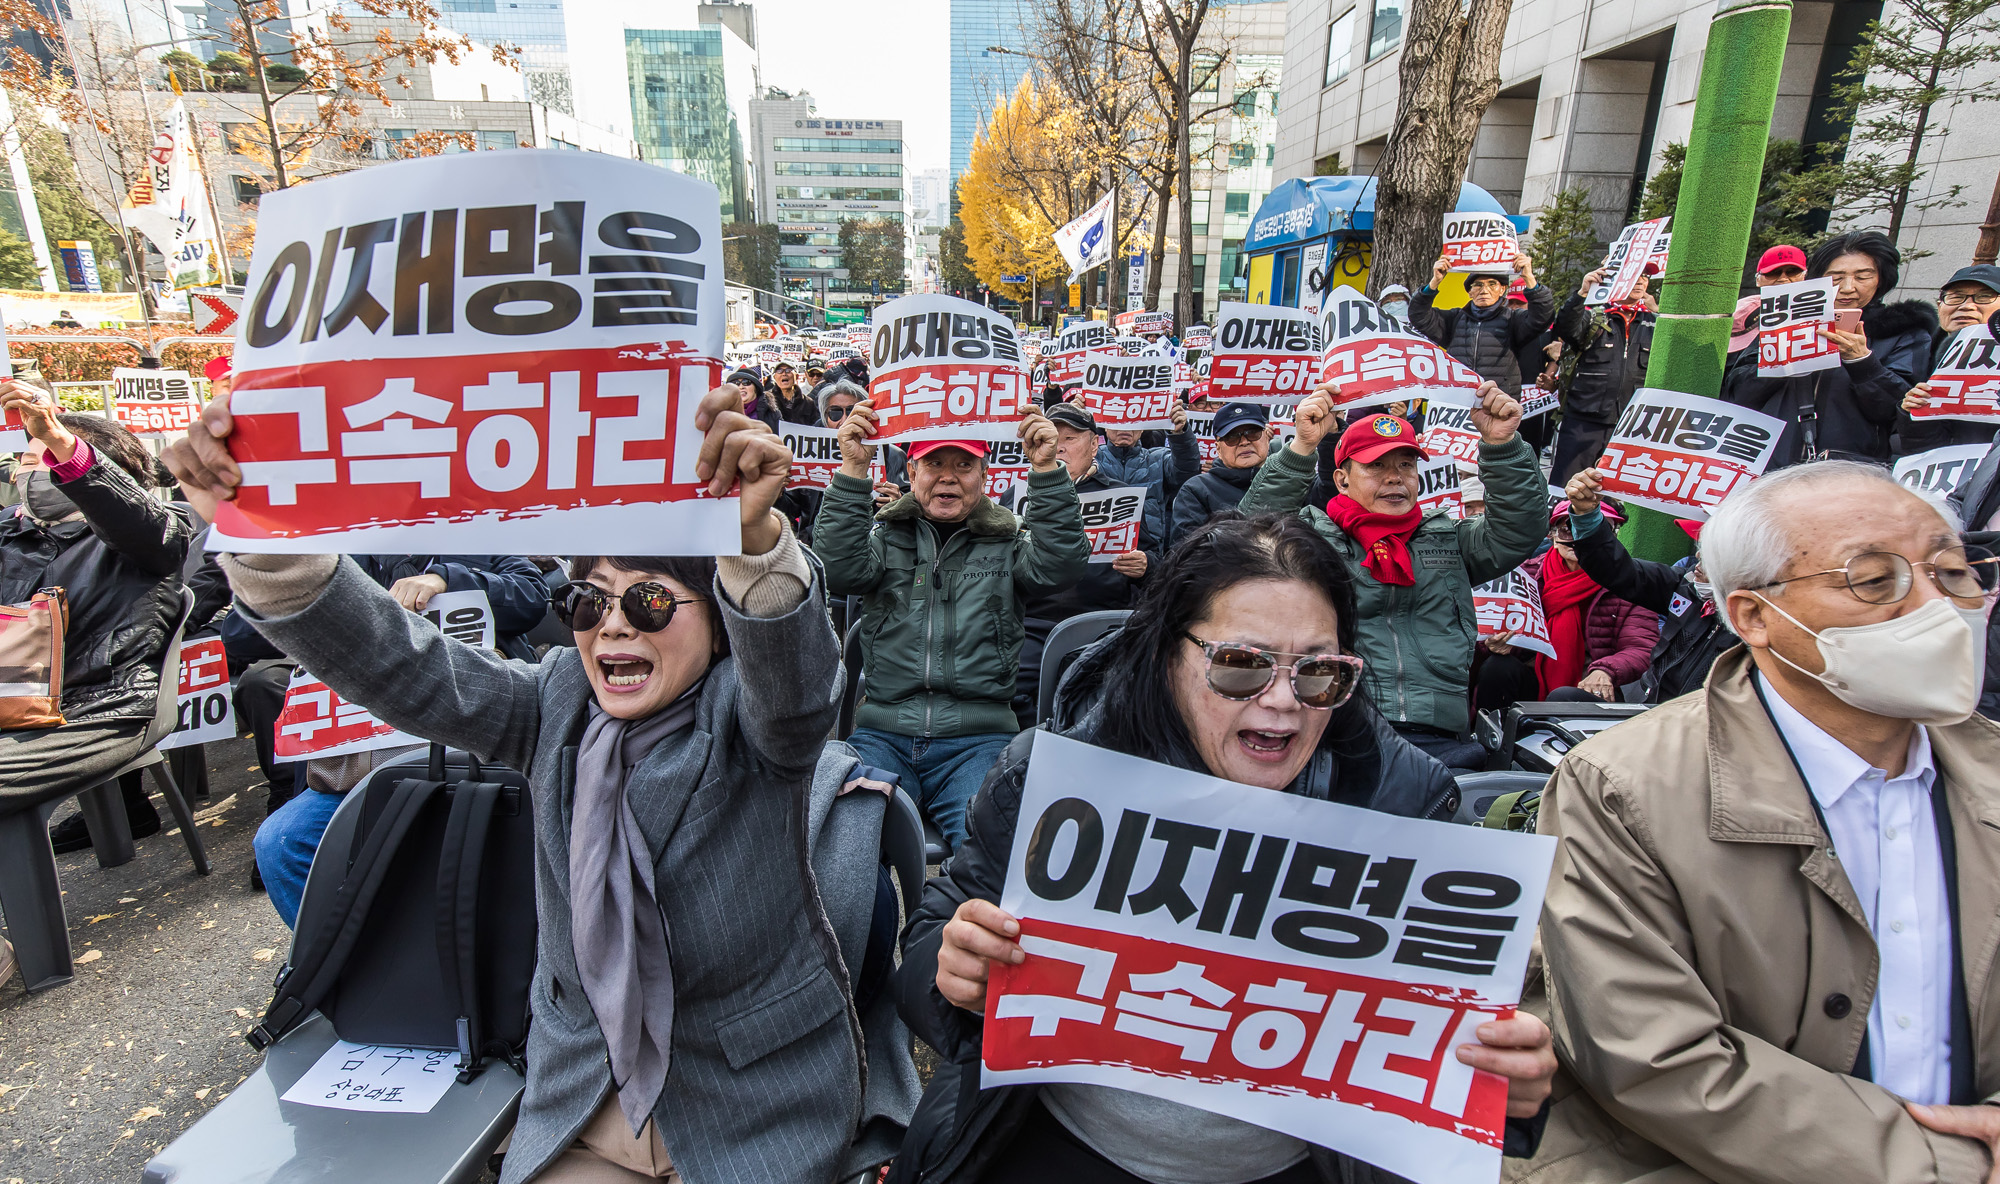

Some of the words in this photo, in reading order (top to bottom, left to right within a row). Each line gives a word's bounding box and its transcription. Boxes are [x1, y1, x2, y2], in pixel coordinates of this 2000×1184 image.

[806, 120, 821, 128] IBS
[1446, 219, 1515, 239] 이재명을
[245, 201, 706, 349] 이재명을
[874, 312, 1020, 369] 이재명을
[115, 378, 190, 400] 이재명을
[1086, 363, 1173, 390] 이재명을
[873, 371, 1032, 426] 구속하라
[1084, 392, 1175, 420] 구속하라
[231, 364, 710, 506] 구속하라
[1614, 403, 1771, 463] 이재명을
[963, 570, 1009, 580] PROPPER
[1024, 797, 1522, 976] 이재명을
[995, 934, 1497, 1119] 구속하라
[325, 1079, 406, 1103] 상임대표
